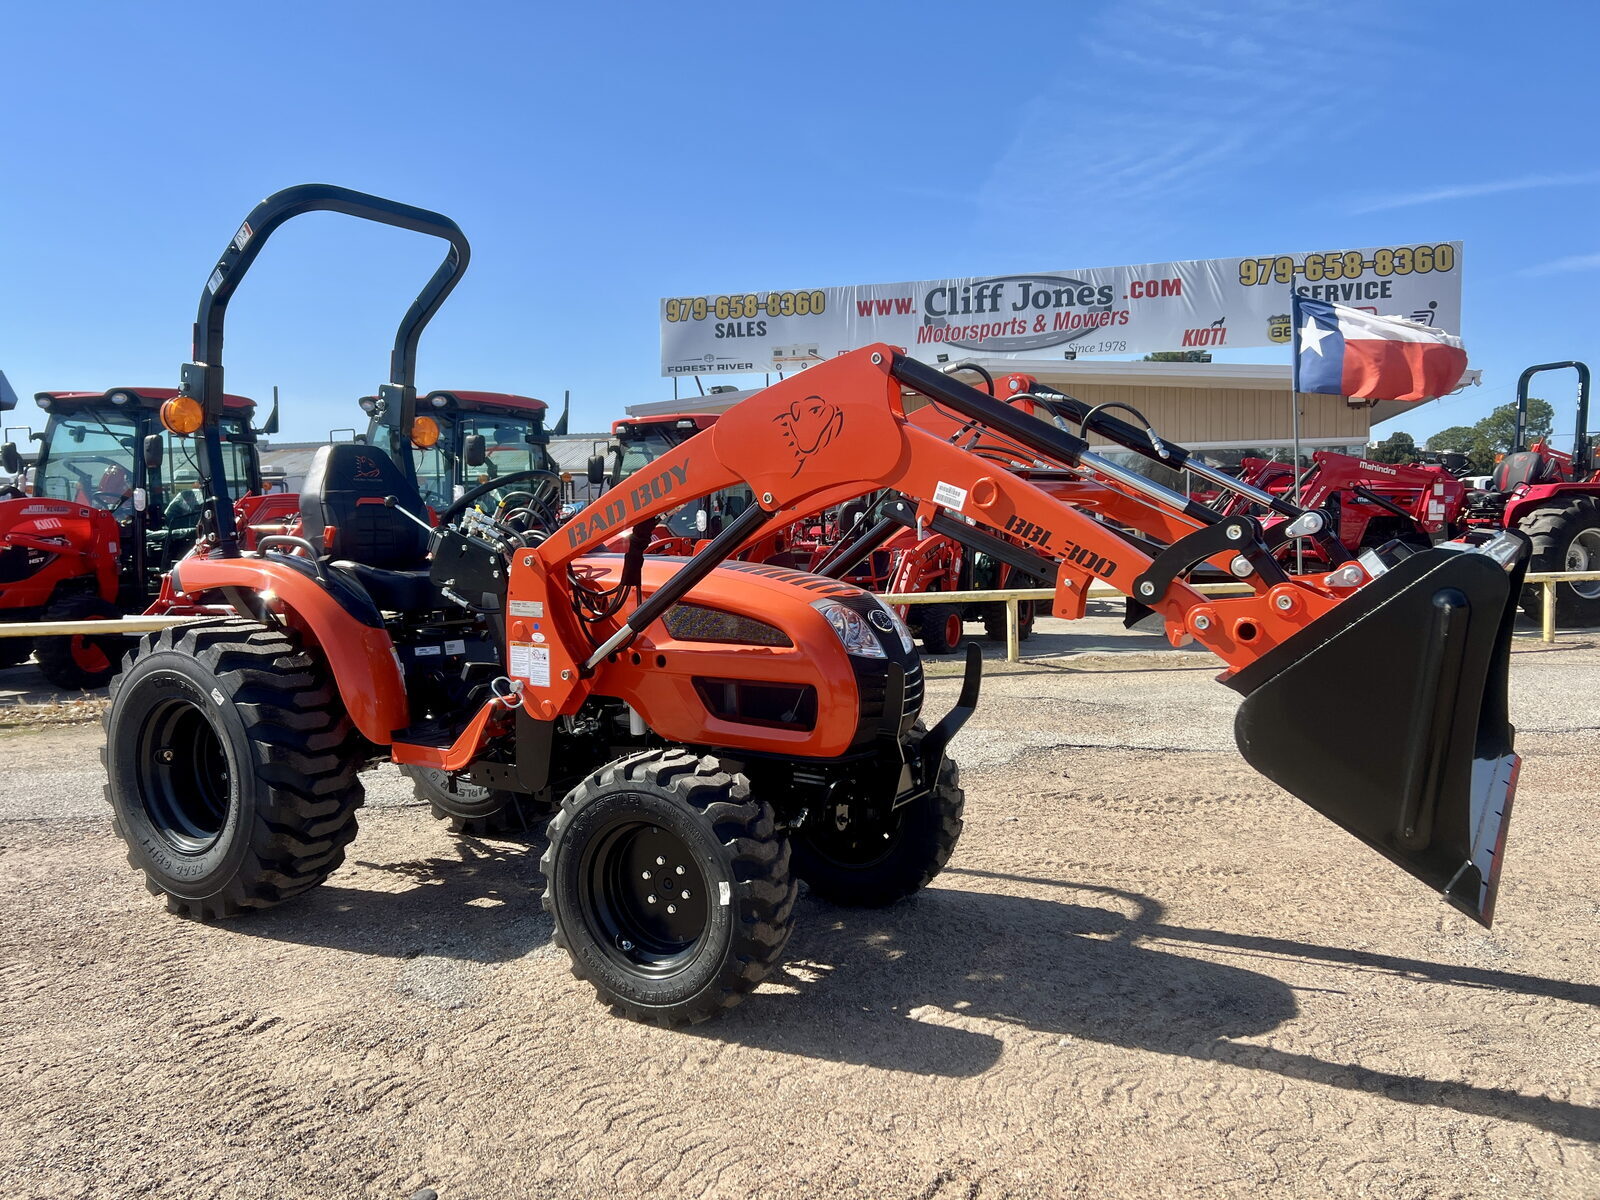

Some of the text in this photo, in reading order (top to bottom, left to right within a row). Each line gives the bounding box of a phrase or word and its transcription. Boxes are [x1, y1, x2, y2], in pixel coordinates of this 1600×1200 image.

[1239, 244, 1454, 286] 979-658-8360
[925, 283, 1004, 317] Cliff
[1012, 283, 1113, 312] Jones
[1123, 278, 1182, 299] .COM
[1297, 280, 1392, 302] SERVICE
[666, 291, 826, 323] 979-658-8360
[715, 321, 767, 338] SALES
[917, 310, 1129, 344] Motorsports & Mowers
[1182, 327, 1227, 346] KIOTI
[1068, 341, 1127, 352] Since 1978
[667, 363, 753, 373] FOREST RIVER
[1360, 461, 1396, 475] Mahindra
[567, 458, 691, 549] BAD BOY
[33, 517, 62, 530] KIOTI
[1004, 514, 1118, 578] BBL 300
